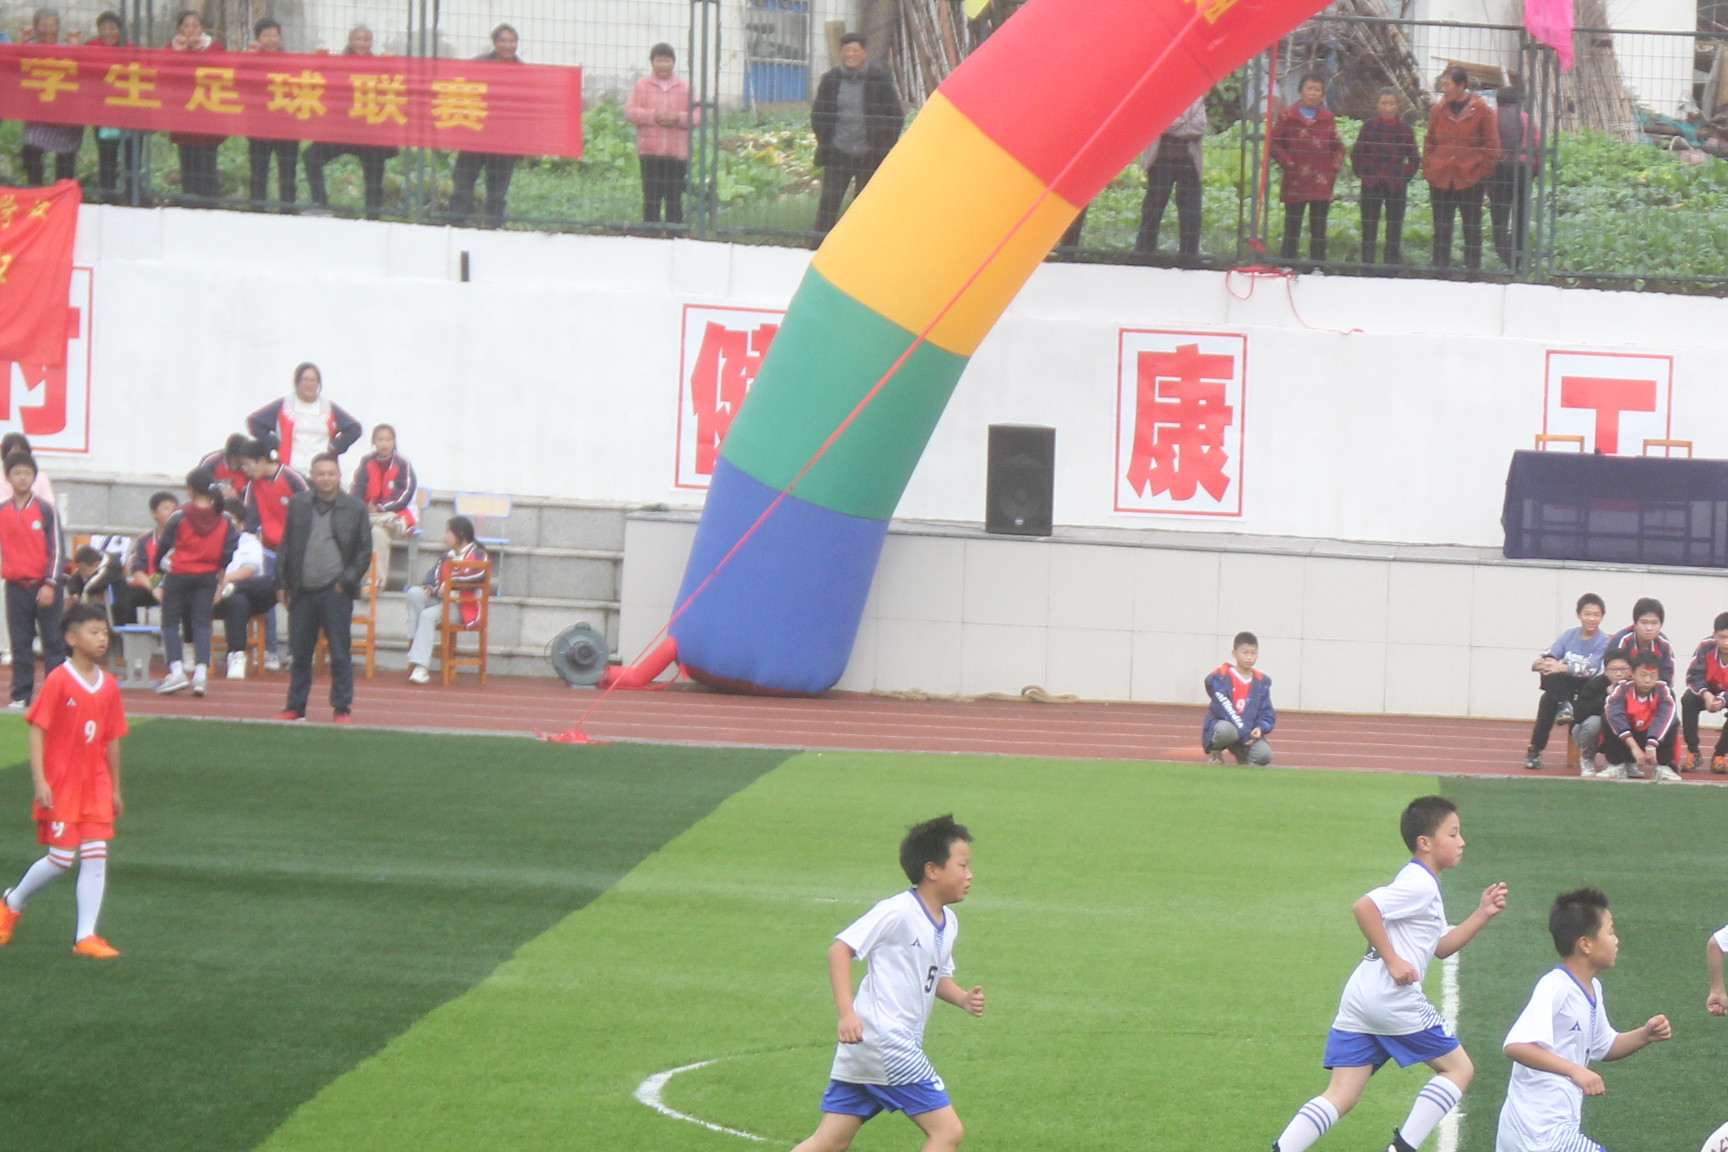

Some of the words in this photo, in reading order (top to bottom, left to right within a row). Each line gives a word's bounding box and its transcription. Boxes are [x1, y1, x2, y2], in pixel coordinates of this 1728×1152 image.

[20, 57, 489, 132] 学生足球联赛
[1126, 343, 1235, 503] 康
[84, 720, 97, 743] 9
[924, 964, 938, 993] 5
